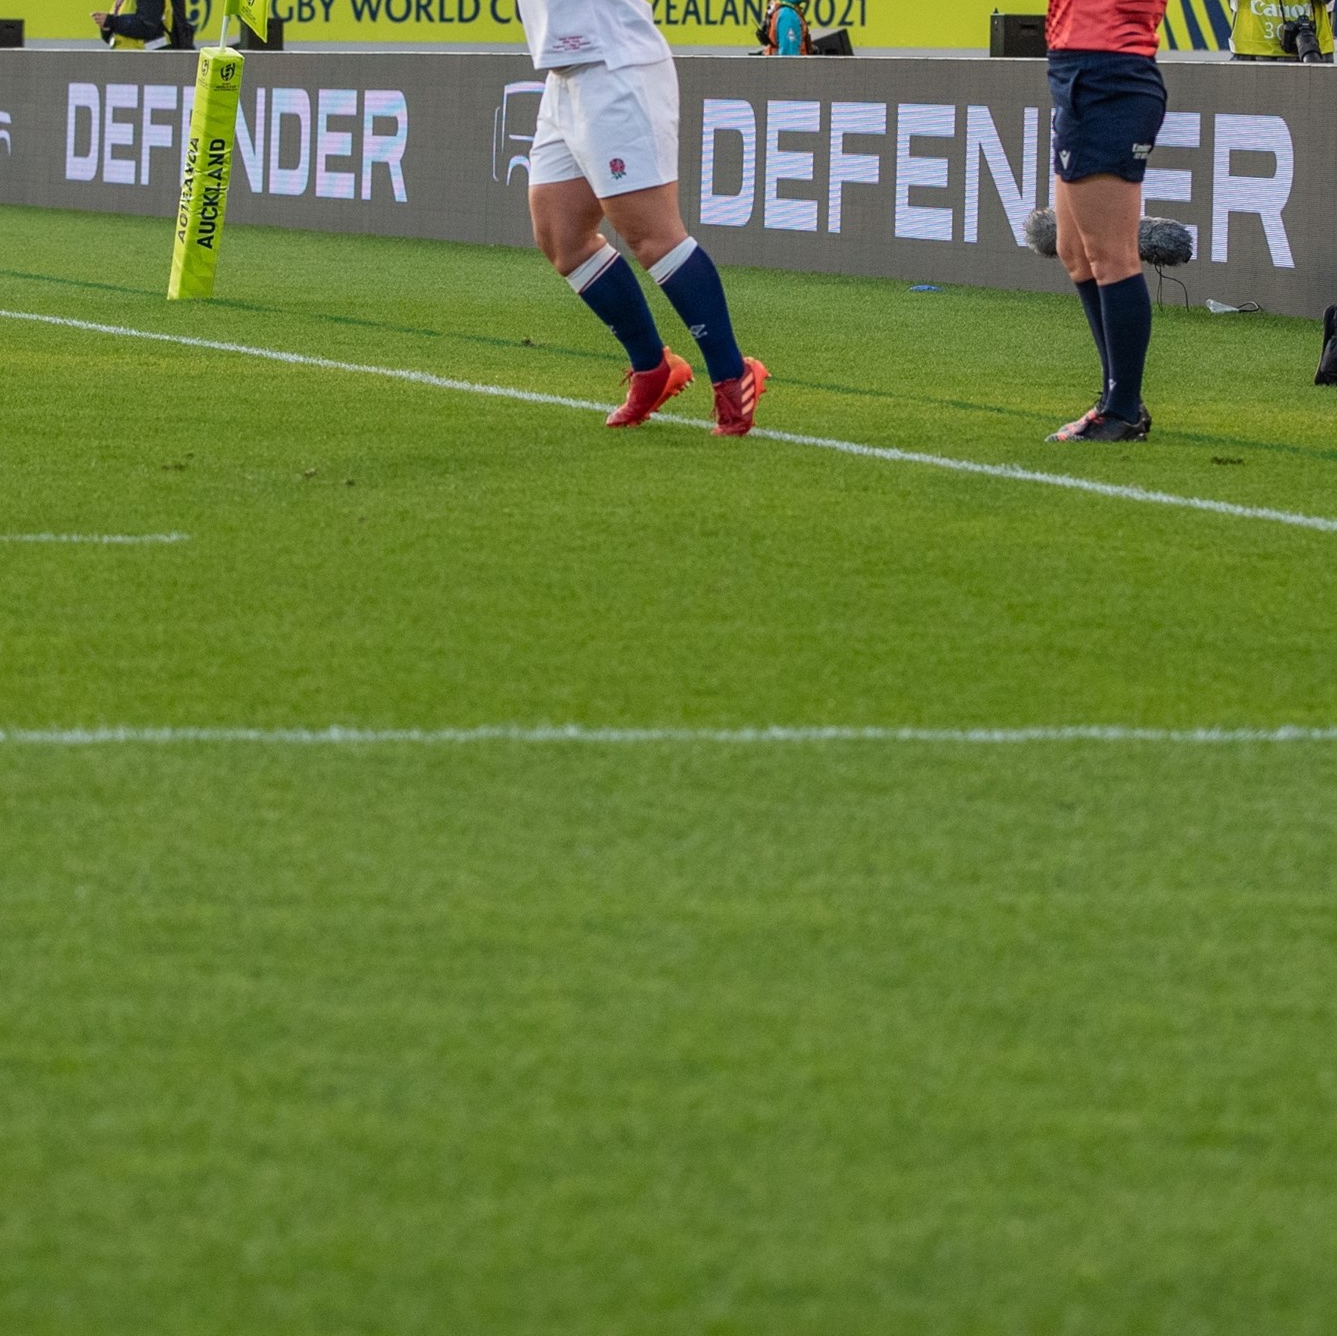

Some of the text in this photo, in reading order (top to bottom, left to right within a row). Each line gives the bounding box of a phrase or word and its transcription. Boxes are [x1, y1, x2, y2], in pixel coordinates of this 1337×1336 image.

[65, 81, 409, 203] DEFNDER
[197, 138, 226, 250] AUCKLAND
[700, 98, 1295, 269] DEFENER
